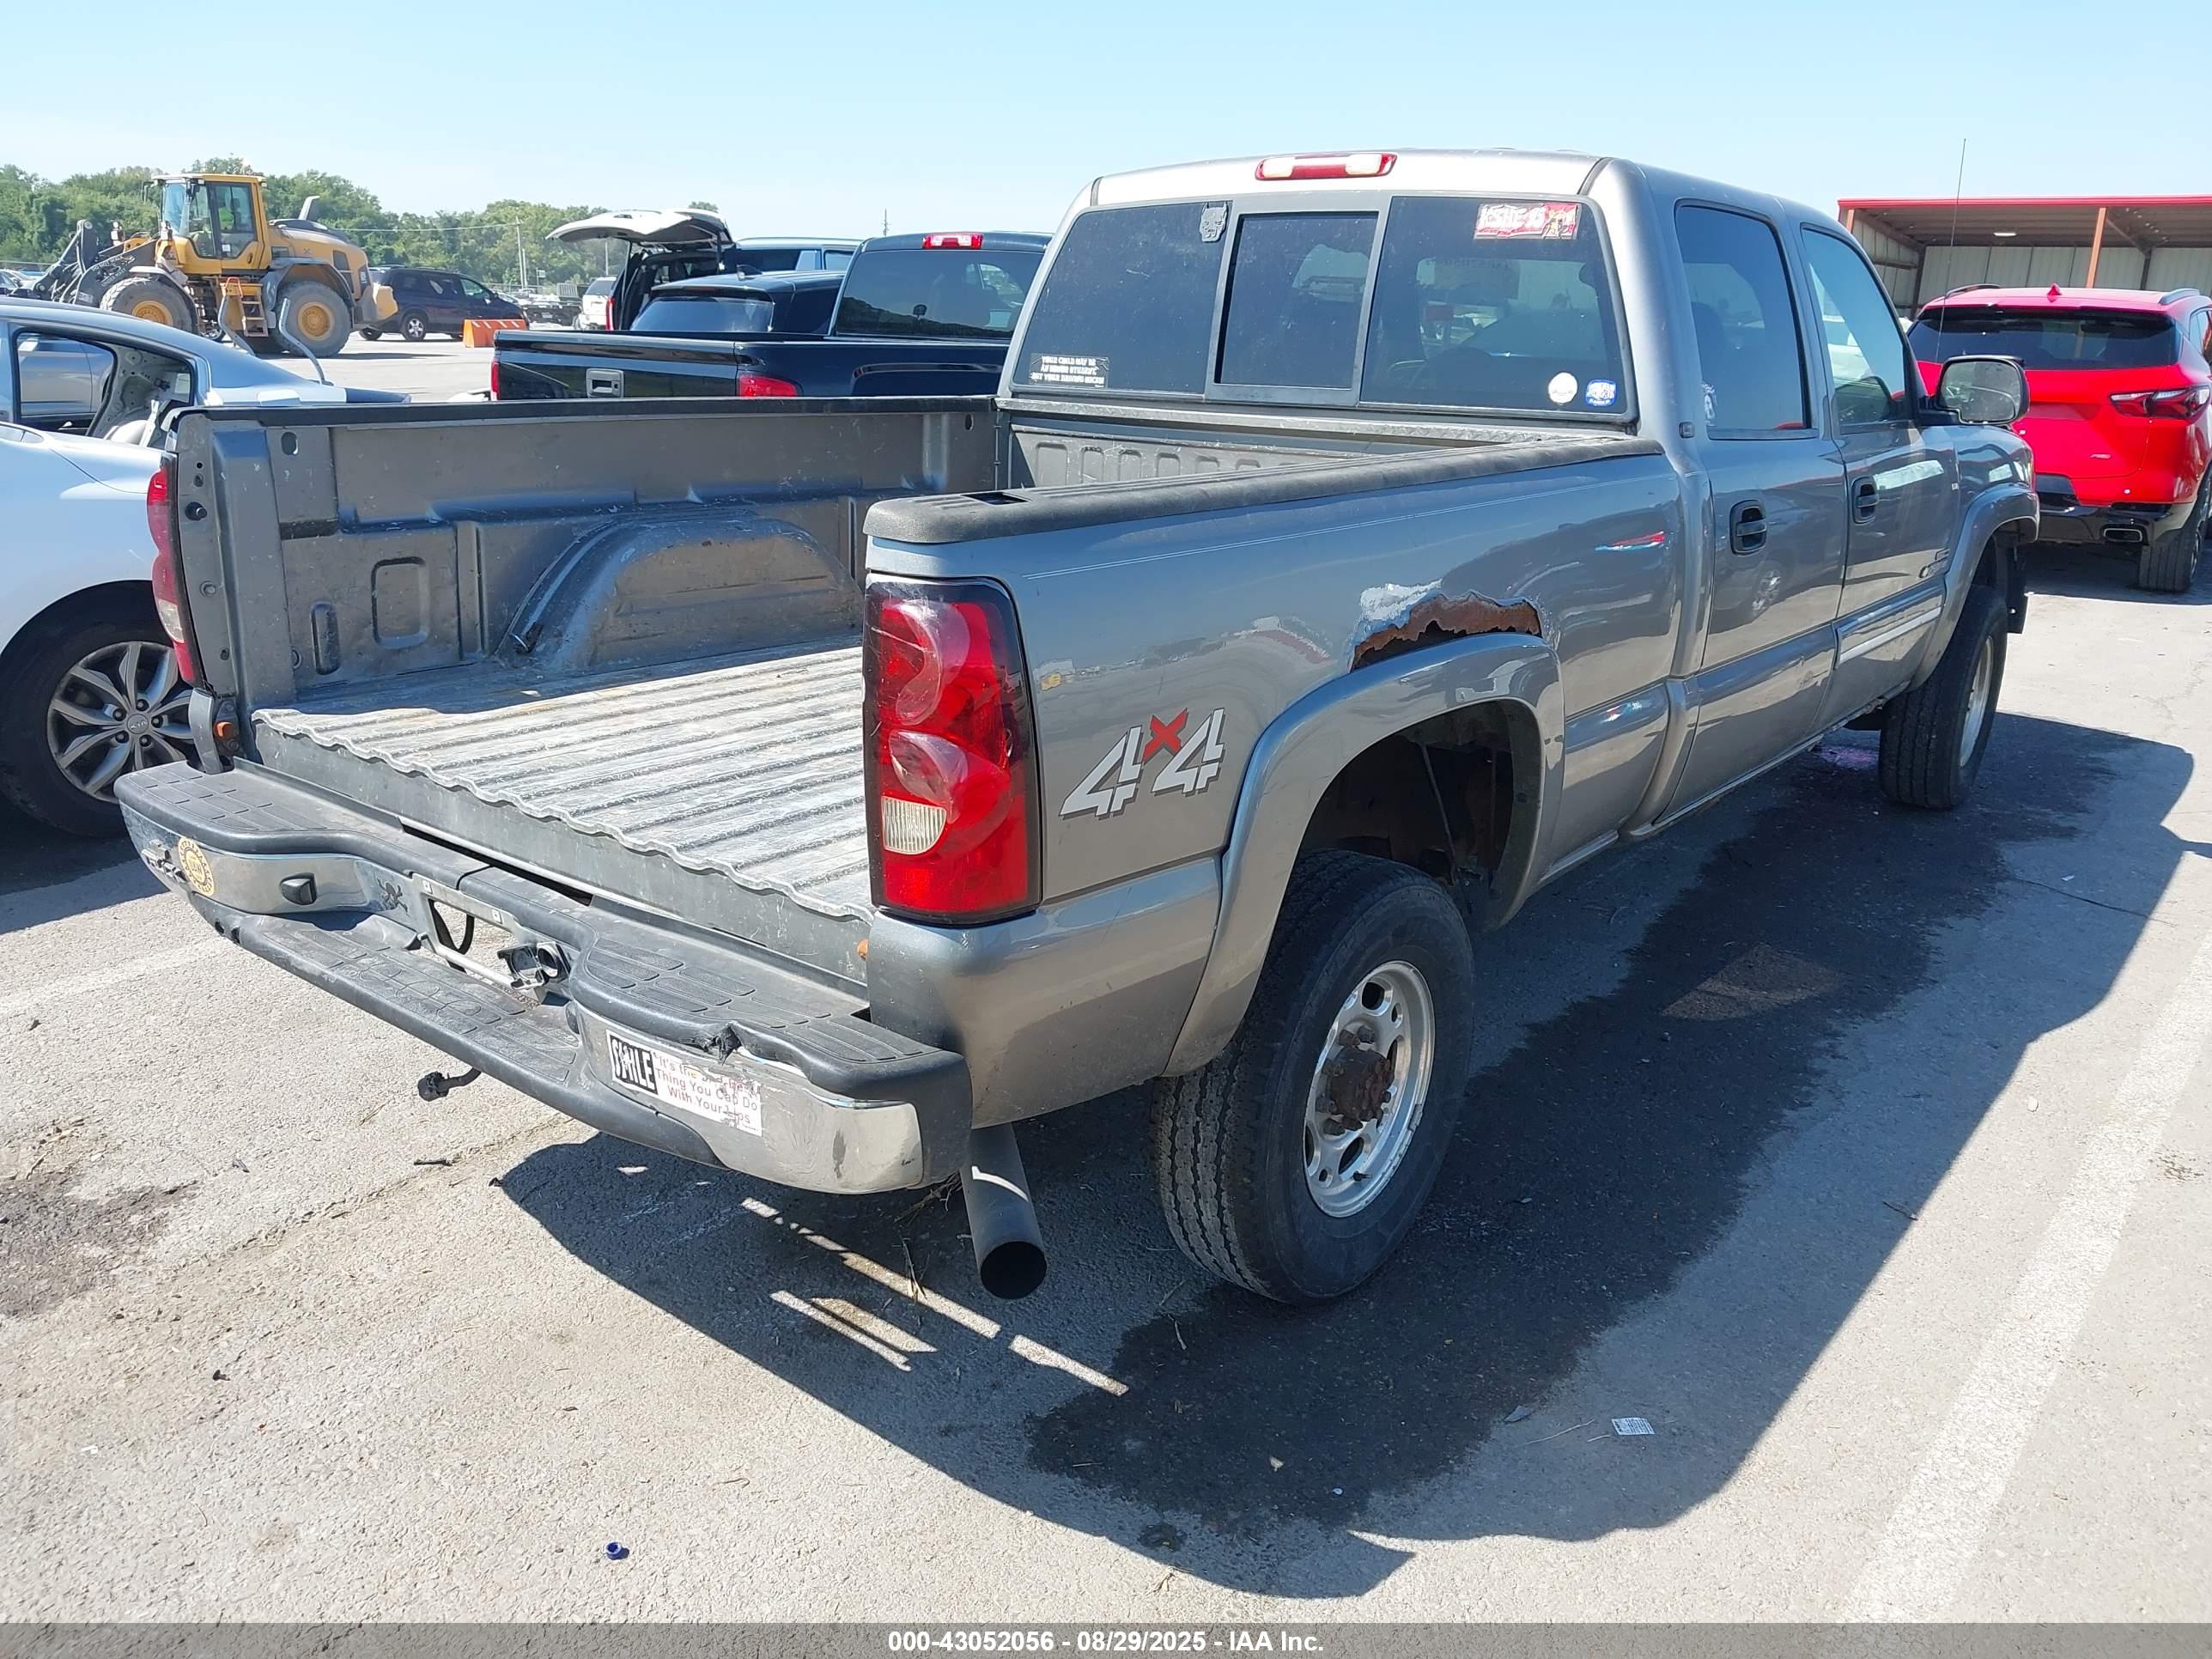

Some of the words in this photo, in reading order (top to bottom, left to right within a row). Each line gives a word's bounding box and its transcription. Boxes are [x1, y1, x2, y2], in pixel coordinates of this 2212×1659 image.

[656, 1068, 686, 1091] Thing
[690, 1080, 711, 1097] You
[743, 1097, 757, 1112] Do
[666, 1085, 693, 1103] With
[696, 1096, 723, 1114] Your
